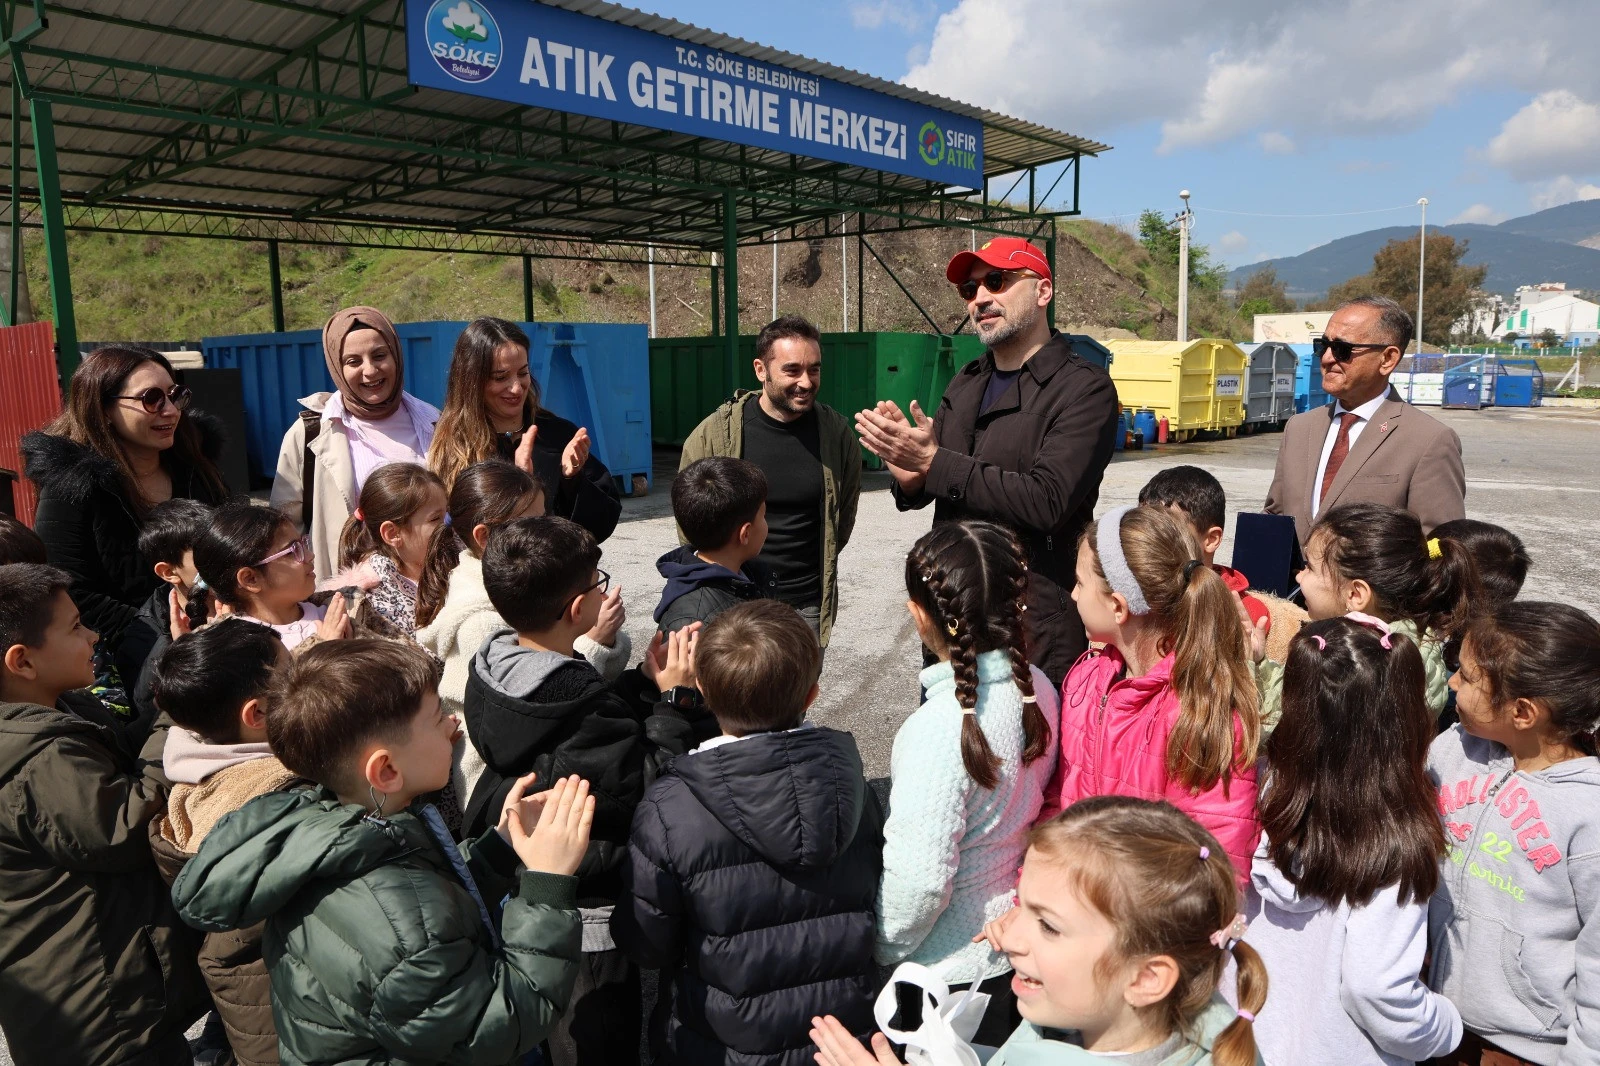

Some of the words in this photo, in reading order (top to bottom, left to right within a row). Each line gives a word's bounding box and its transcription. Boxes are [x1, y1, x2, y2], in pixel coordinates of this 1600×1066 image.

[433, 41, 497, 68] SÖKE
[452, 63, 480, 76] Belediyesi
[675, 46, 702, 69] T.C.
[706, 52, 744, 79] SÖKE
[747, 64, 820, 97] BELEDİYESİ
[519, 36, 618, 102] ATIK
[627, 61, 780, 135] GETİRME
[789, 97, 907, 161] MERKEZİ
[946, 129, 977, 153] SIFIR
[946, 146, 977, 171] ATIK
[1216, 377, 1239, 388] PLASTİK
[1479, 831, 1513, 864] 22
